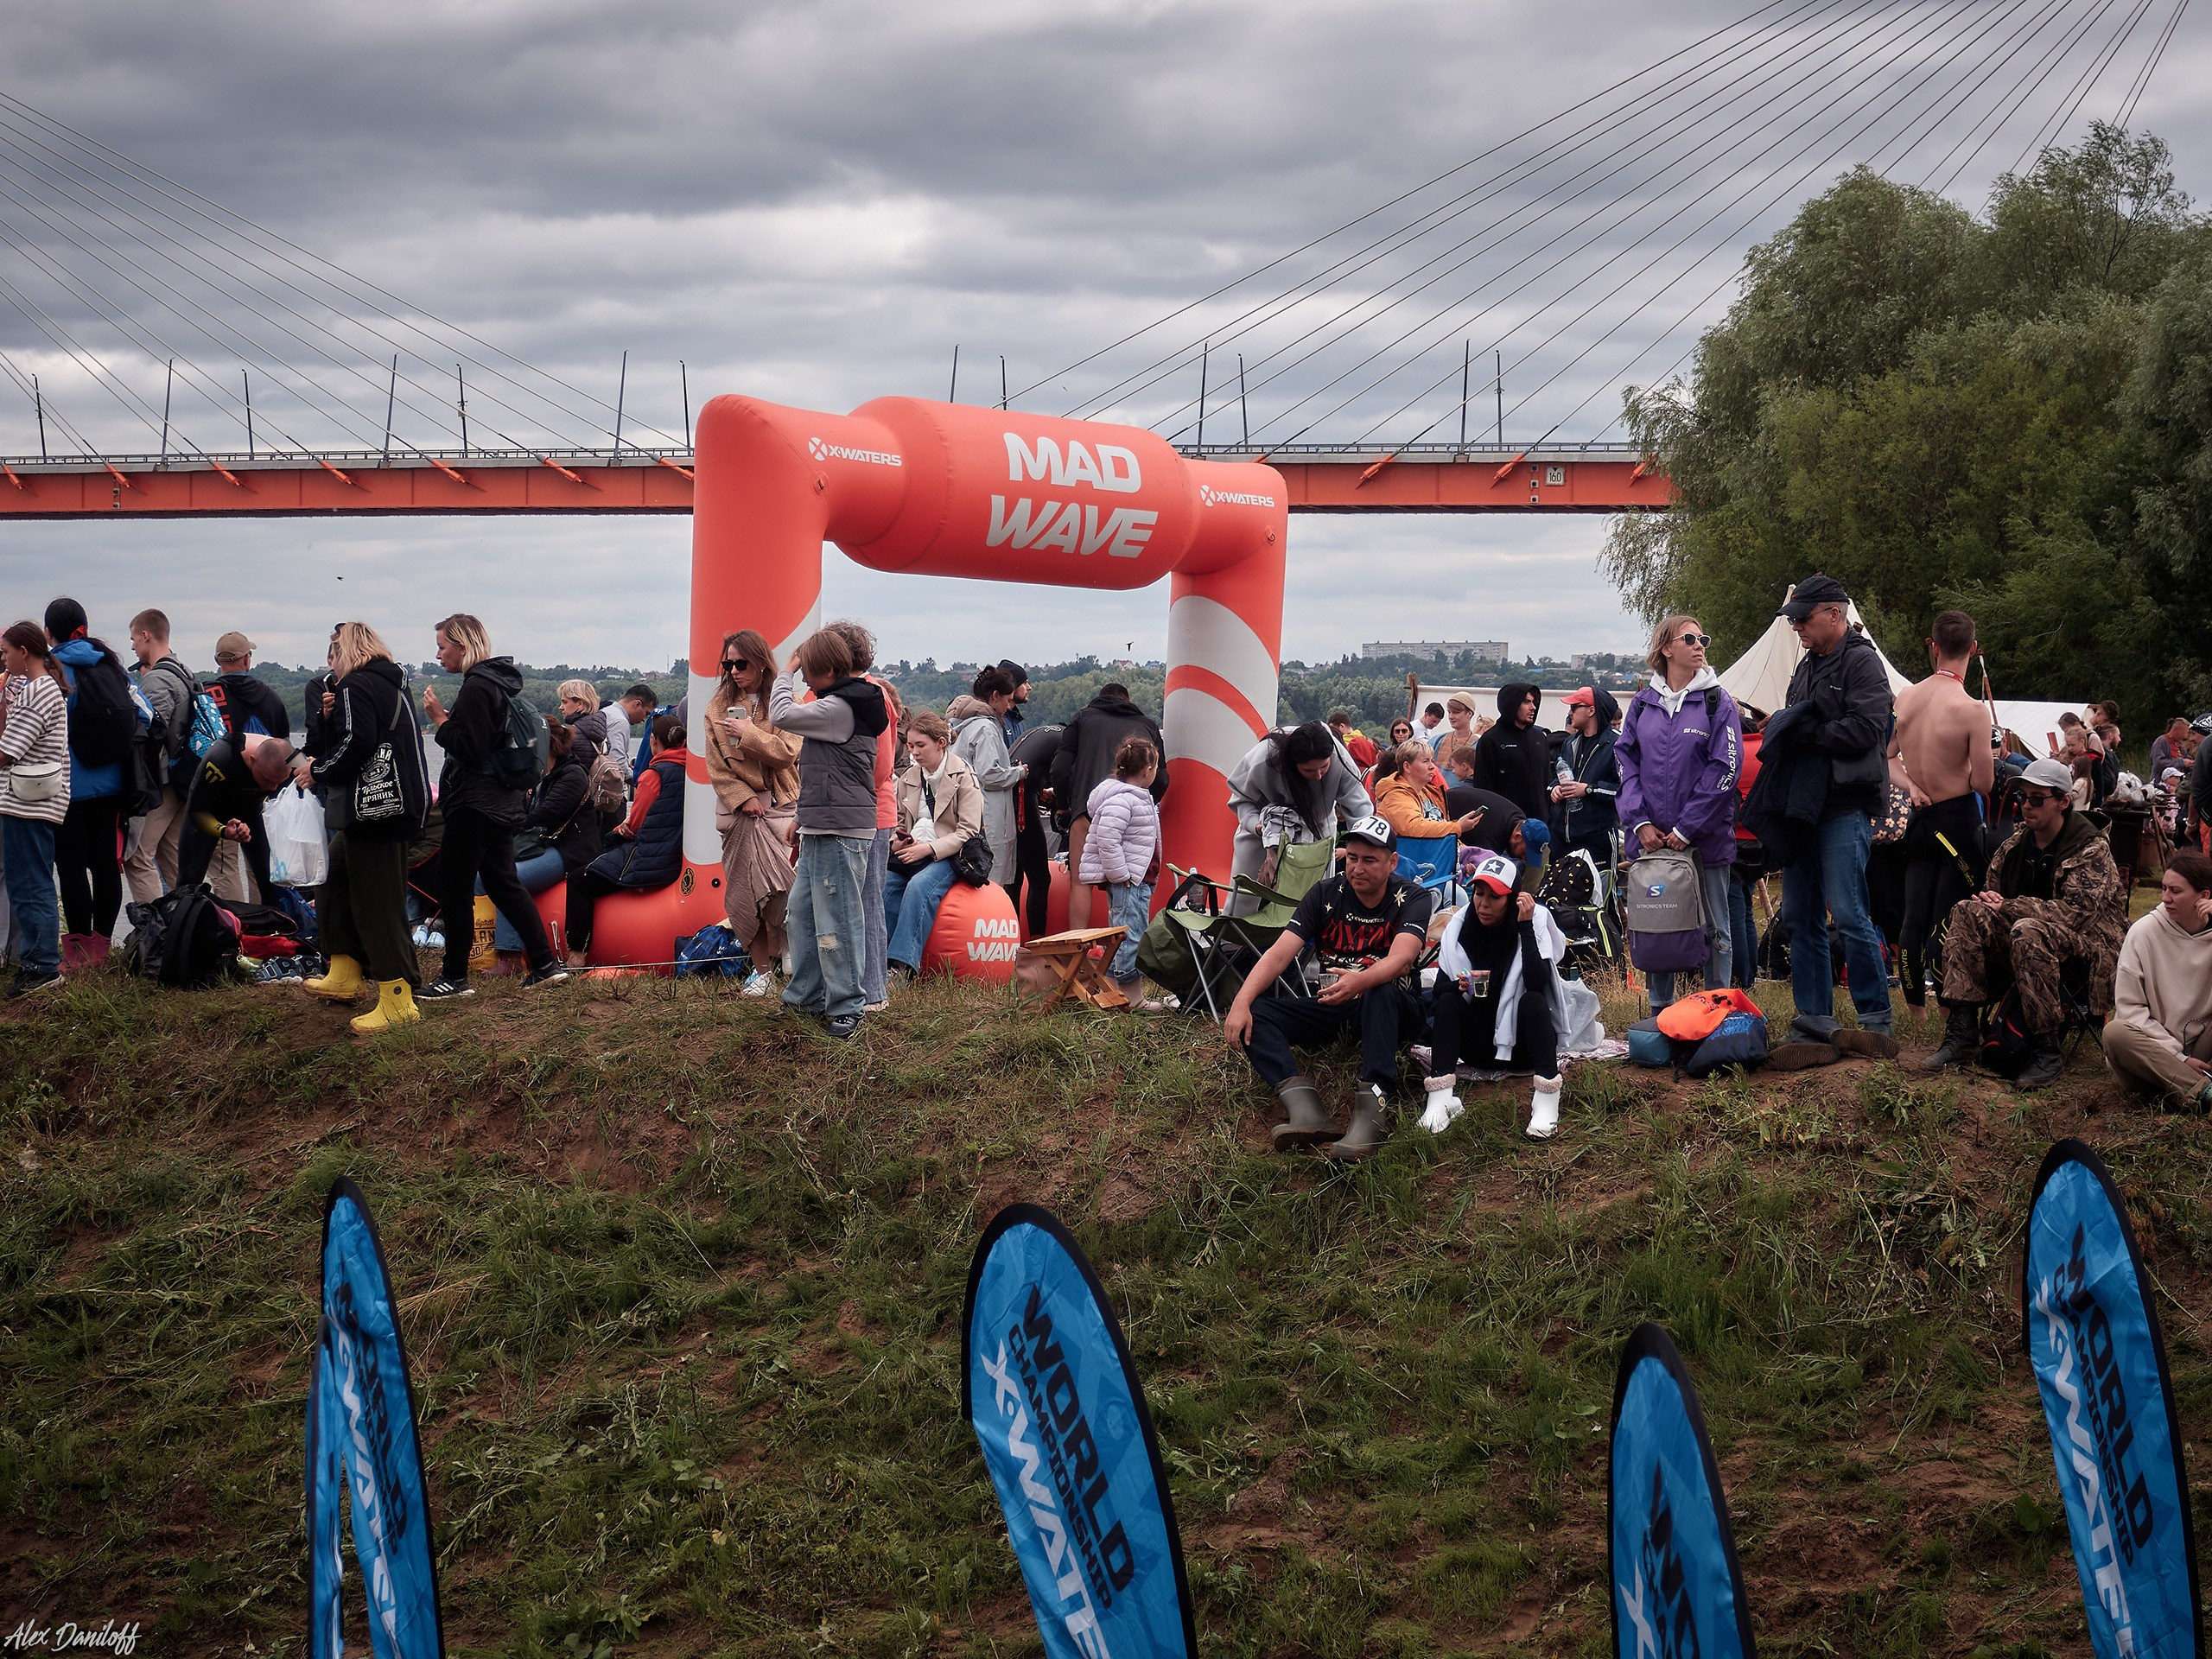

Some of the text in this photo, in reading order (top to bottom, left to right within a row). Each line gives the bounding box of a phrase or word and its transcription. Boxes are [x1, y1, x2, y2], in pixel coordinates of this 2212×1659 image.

[1003, 432, 1141, 493] MAD
[986, 494, 1159, 558] WAVE
[363, 791, 394, 804] ПРЯНИК
[1366, 817, 1387, 836] 78
[974, 918, 1019, 938] MAD
[2054, 1262, 2133, 1567] CHAMPIONSHIP
[2070, 1220, 2154, 1550] WORLD
[1008, 1324, 1112, 1610] CHAMPIONSHIP
[1022, 1282, 1135, 1593] WORLD
